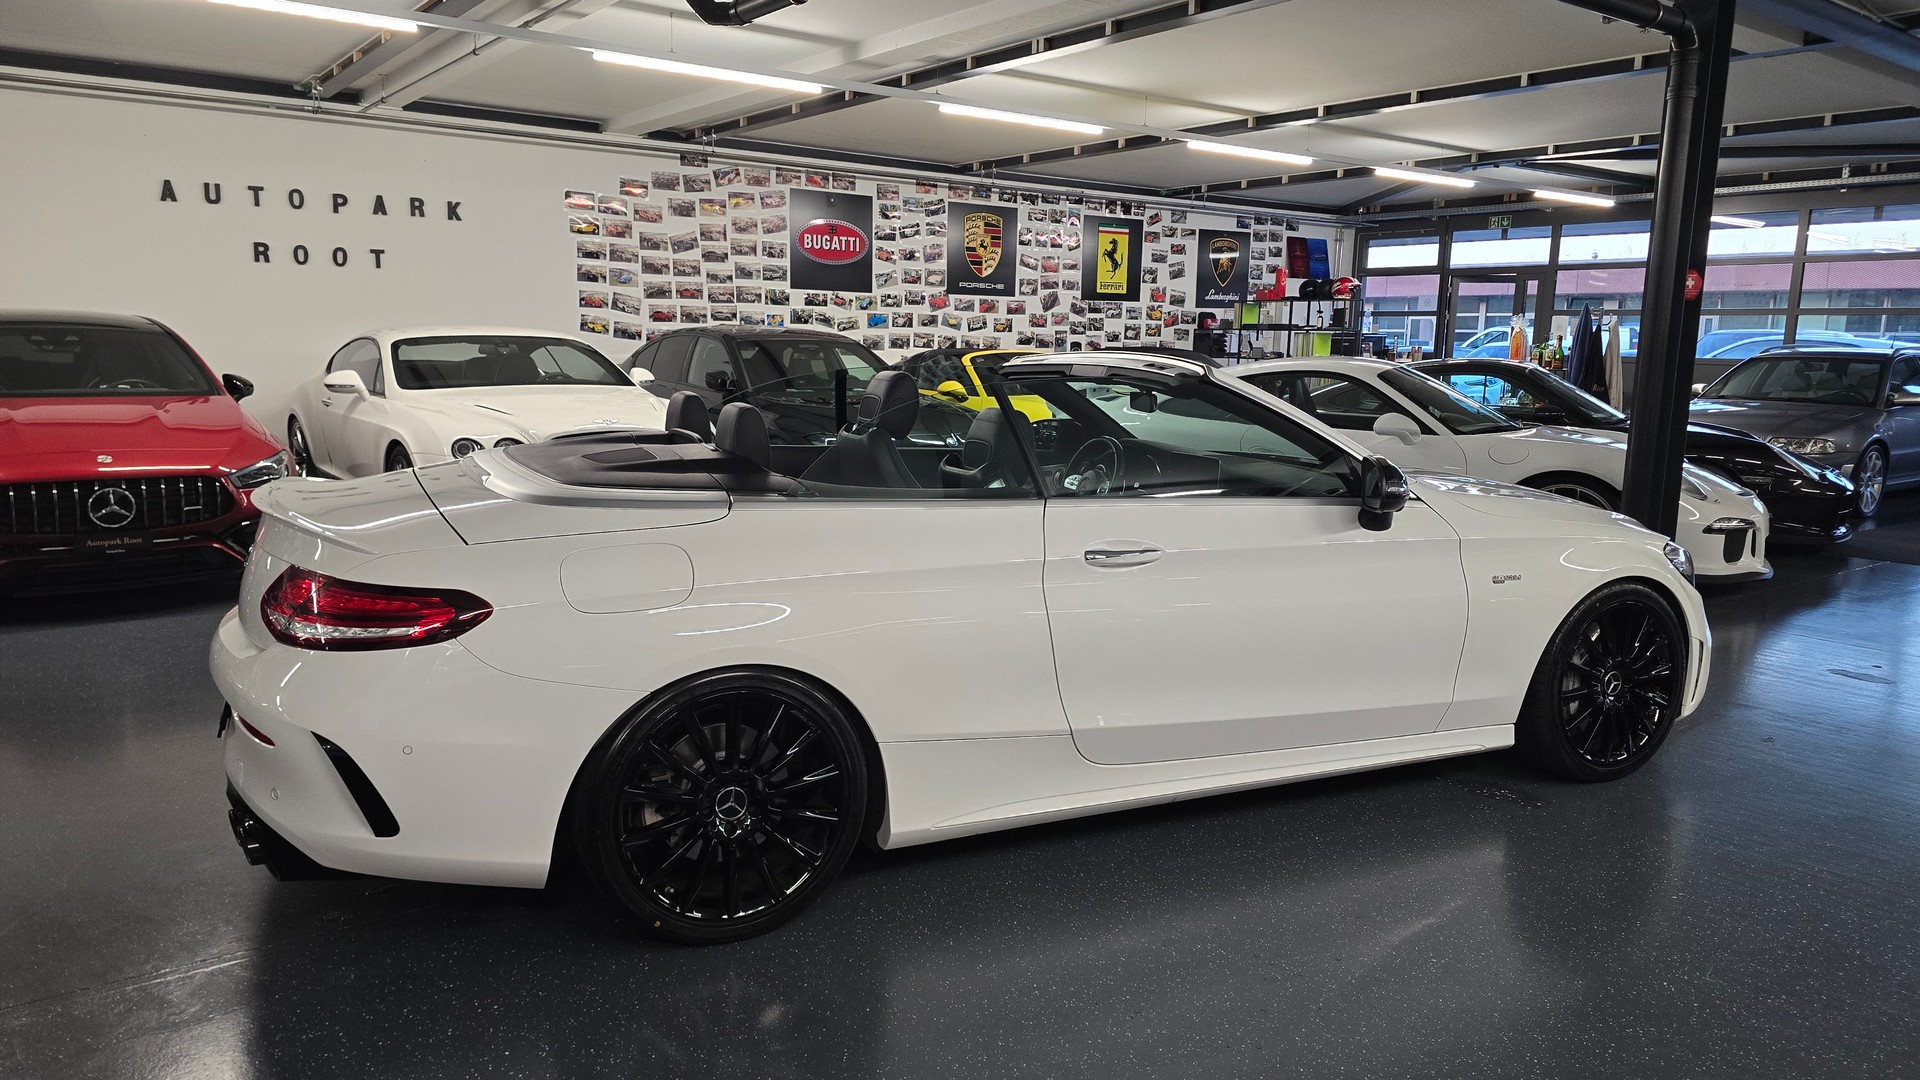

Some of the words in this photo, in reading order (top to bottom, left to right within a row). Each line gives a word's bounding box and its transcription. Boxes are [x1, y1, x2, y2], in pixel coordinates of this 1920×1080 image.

[160, 179, 463, 222] AUTOPARK
[965, 213, 1002, 226] PORSCHE
[803, 233, 861, 253] BUGATTI
[253, 241, 386, 269] ROOT
[958, 281, 1005, 290] PORSCHE
[1099, 281, 1125, 291] Ferrari
[1204, 288, 1241, 303] Lamborghini
[86, 538, 121, 547] Autopark
